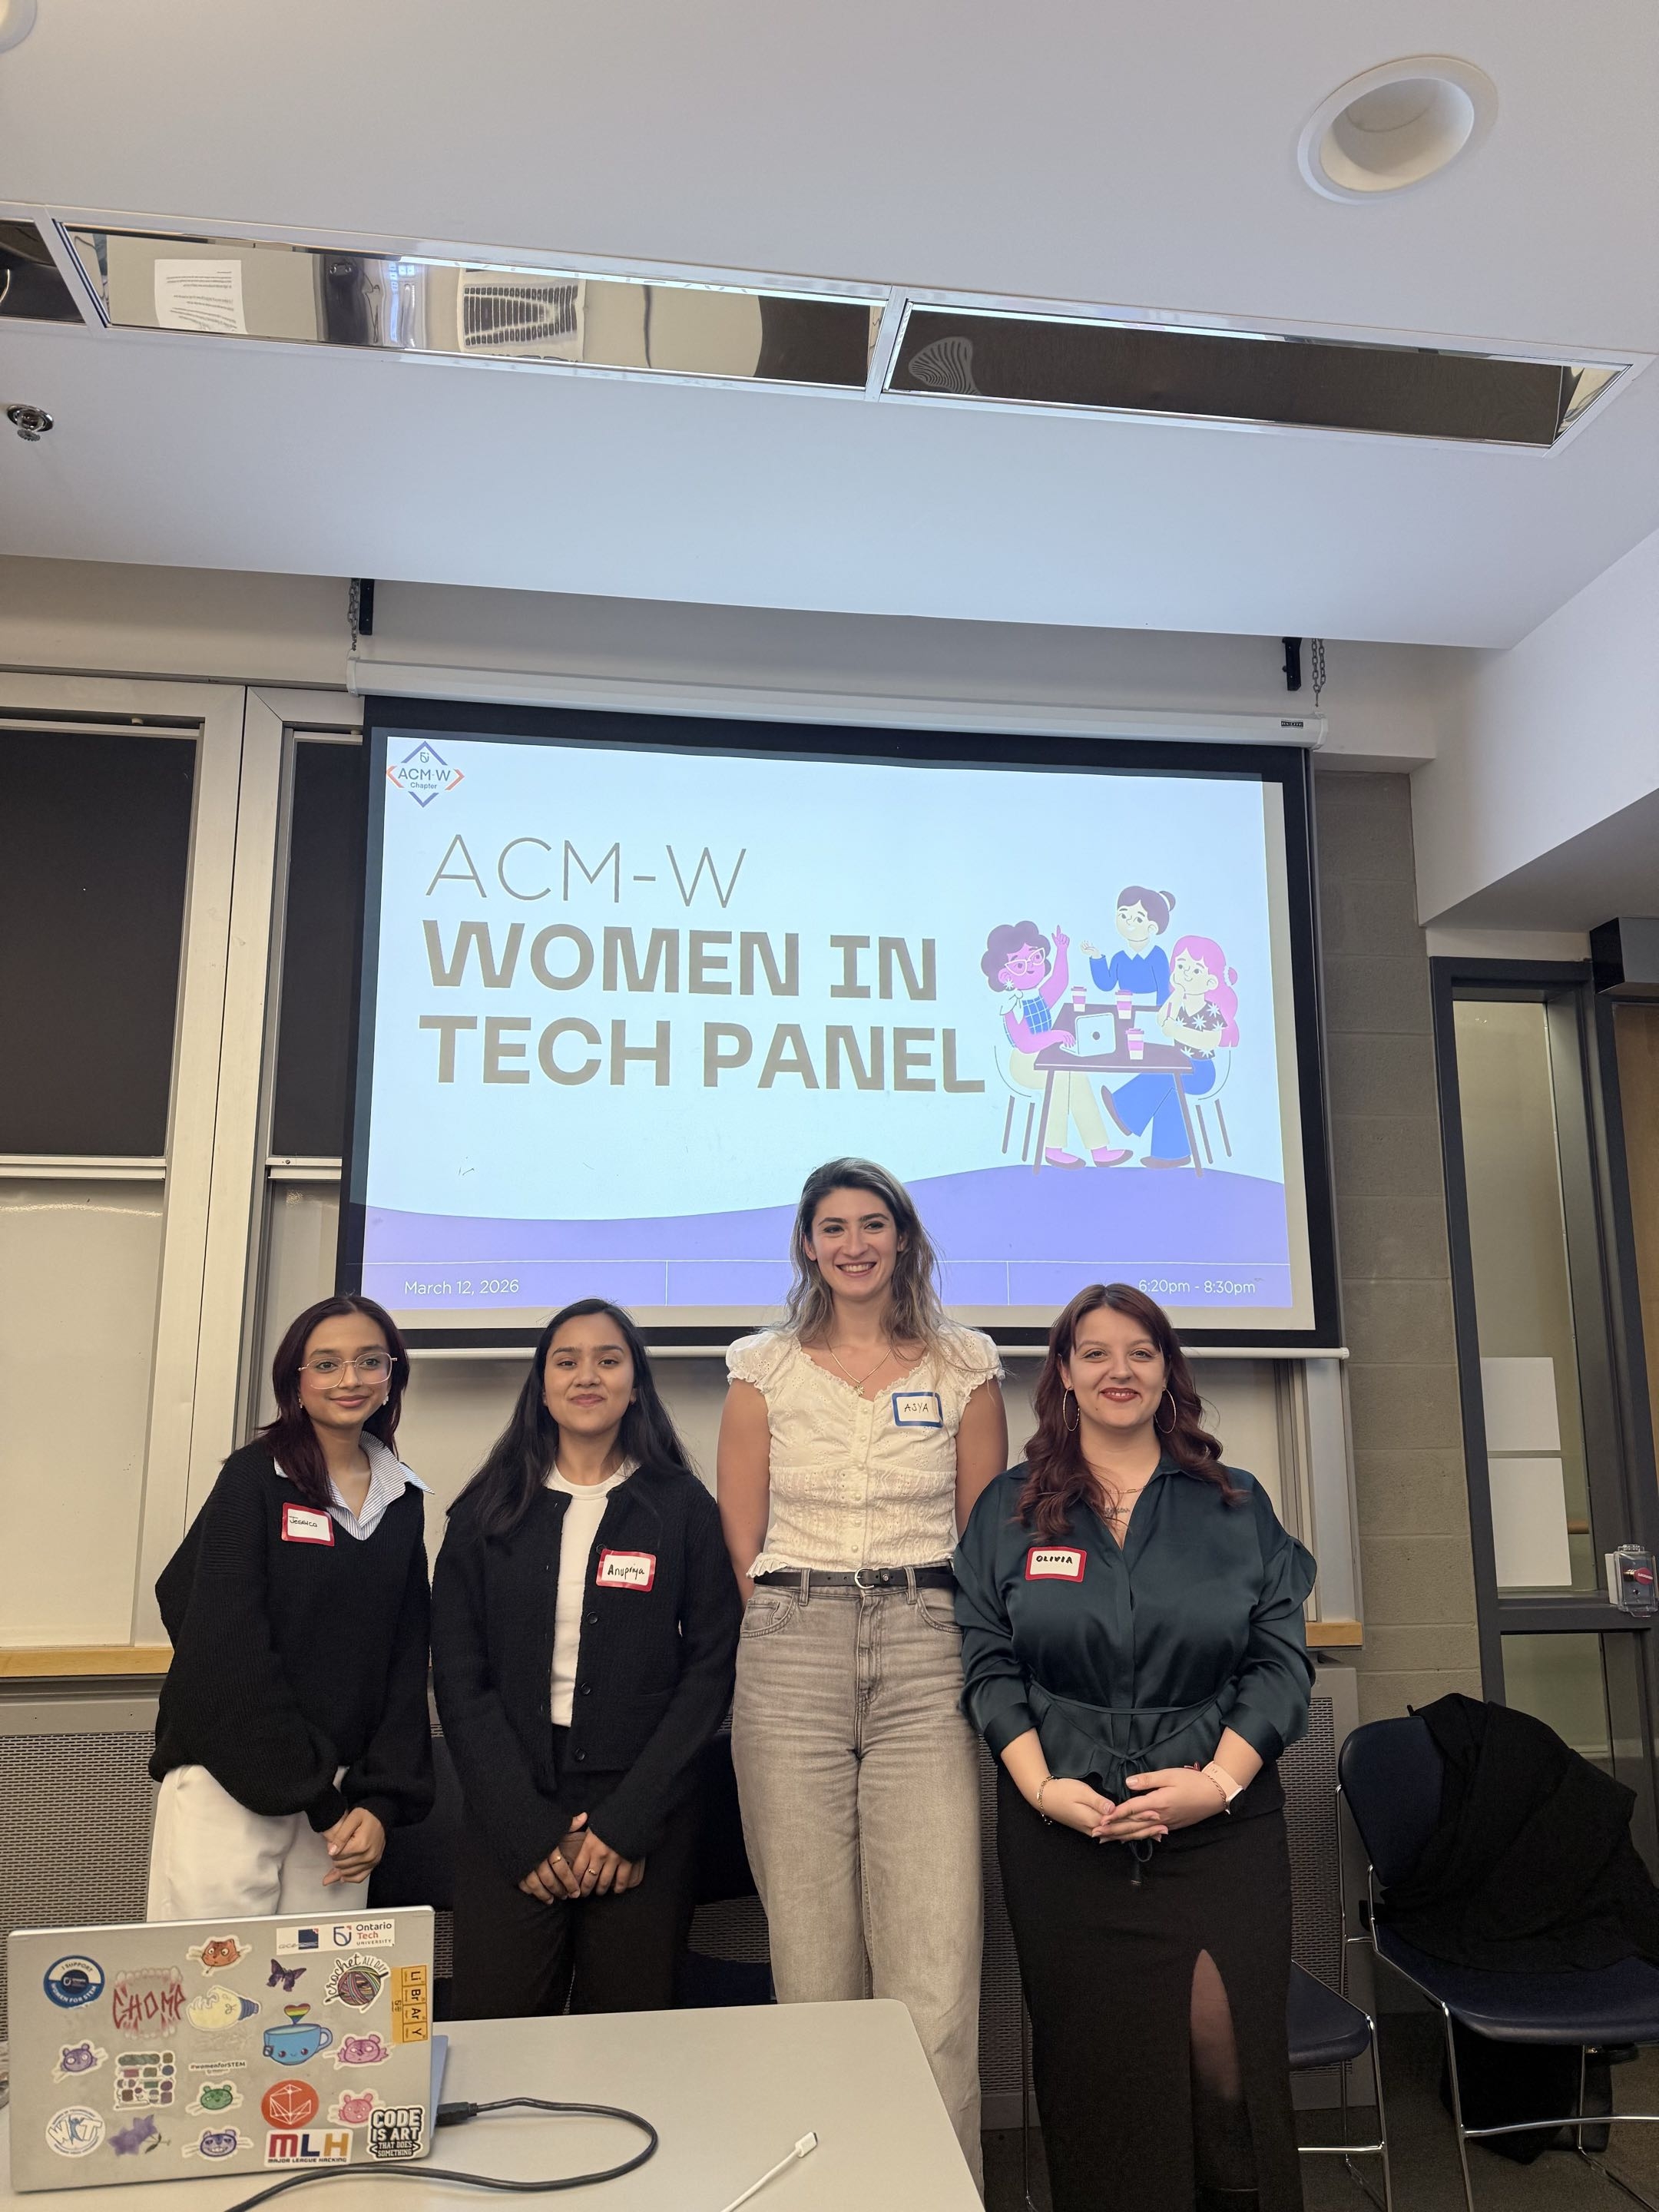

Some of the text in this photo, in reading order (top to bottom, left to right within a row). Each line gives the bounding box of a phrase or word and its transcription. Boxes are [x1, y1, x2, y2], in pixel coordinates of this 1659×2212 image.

[398, 767, 451, 782] ACM-W
[410, 782, 437, 790] Chapter
[426, 834, 747, 909] ACM-W
[422, 919, 936, 1001] WOMEN IN
[419, 1015, 985, 1094] TECH PANEL
[405, 1279, 519, 1296] March 12, 2026
[1138, 1279, 1190, 1294] 6:20pm
[1204, 1280, 1256, 1295] 8:30pm
[904, 1402, 929, 1413] ASYA
[1035, 1555, 1073, 1565] OLIVIA
[608, 1563, 645, 1581] Anupriya
[356, 1922, 392, 1932] Ontario
[65, 1962, 93, 1972] SUPPORT
[326, 1953, 388, 1995] crochet ALL DAY
[83, 1985, 97, 2000] STEM
[112, 1984, 186, 2029] CHOMP
[373, 2109, 422, 2128] CODE
[372, 2127, 420, 2142] IS ART
[269, 2133, 349, 2157] MLH
[378, 2141, 412, 2150] THAT DOES
[377, 2149, 412, 2157] SOMETHING
